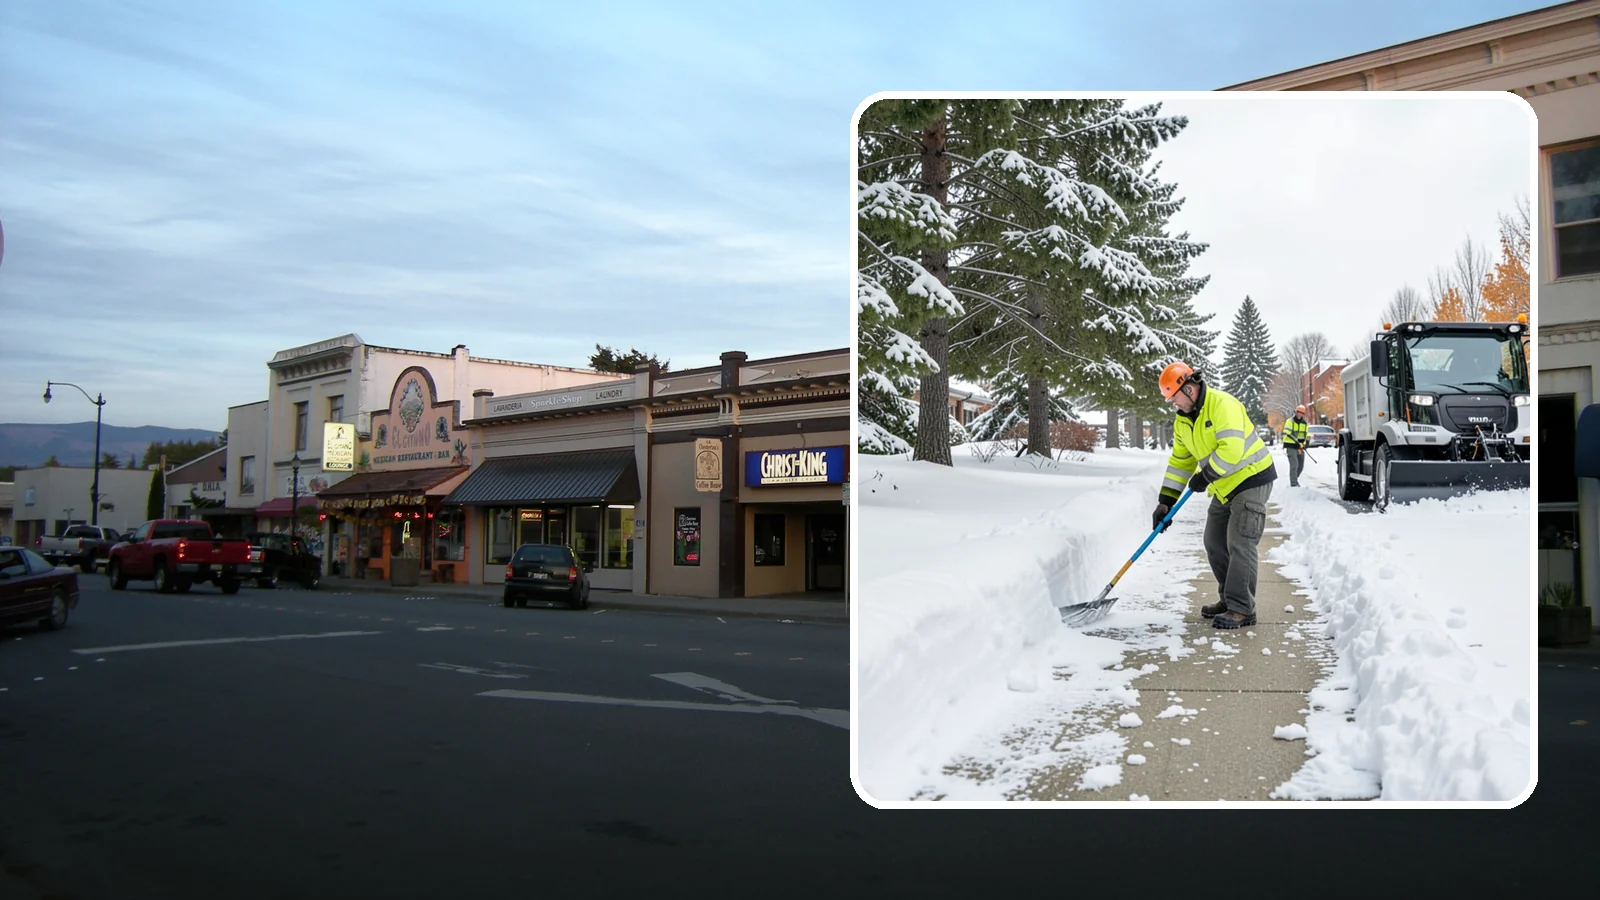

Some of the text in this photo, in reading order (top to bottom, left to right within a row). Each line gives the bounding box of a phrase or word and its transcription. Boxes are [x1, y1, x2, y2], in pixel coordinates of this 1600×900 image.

[531, 394, 582, 409] Sparkle Shop
[595, 389, 624, 400] LAUNDRY
[493, 402, 522, 412] LAVANDERIA
[374, 454, 396, 464] MEXICAN
[397, 451, 433, 462] RESTAURANT
[438, 450, 450, 459] BAR
[761, 452, 797, 478] CHRIST
[799, 449, 827, 476] KING
